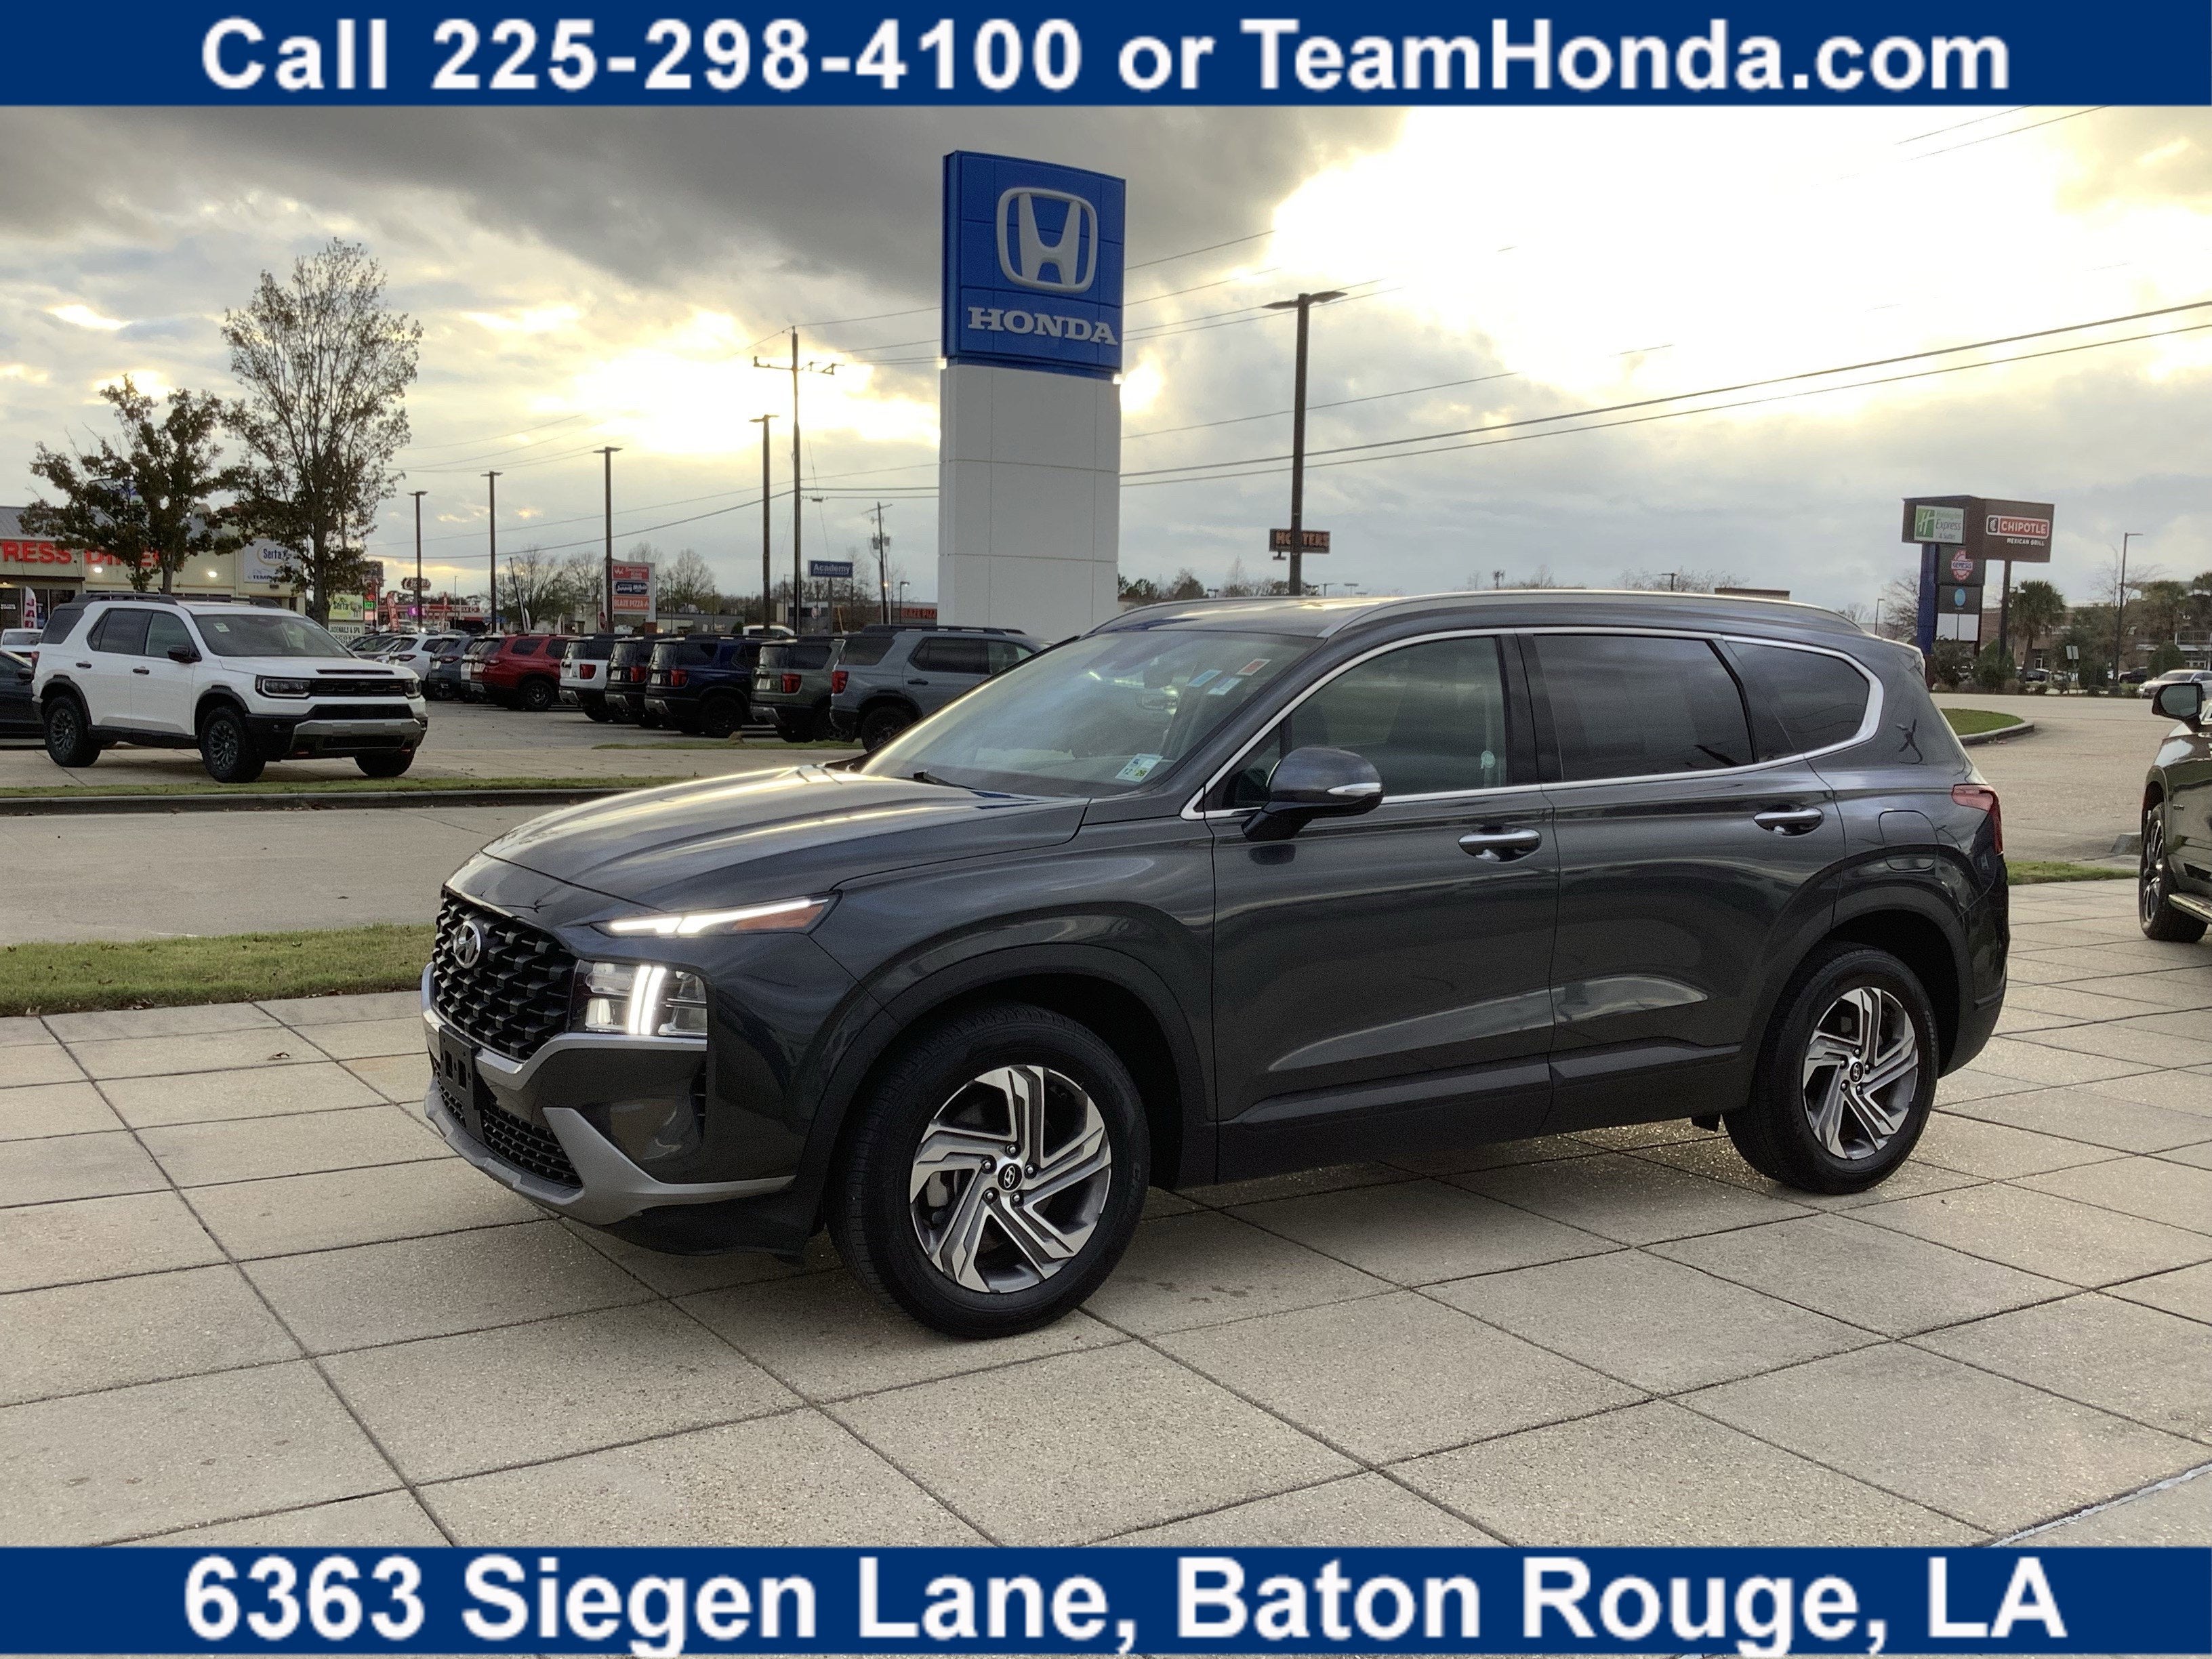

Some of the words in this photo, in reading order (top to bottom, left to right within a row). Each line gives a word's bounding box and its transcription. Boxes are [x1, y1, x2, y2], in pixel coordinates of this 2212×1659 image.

[968, 307, 1118, 346] HONDA
[1936, 518, 1961, 531] Express
[2001, 520, 2047, 535] CHIPOTLE
[1275, 531, 1329, 547] HOTERS
[2, 541, 72, 565] RESS
[263, 548, 282, 559] Serta
[813, 563, 851, 574] Academy
[630, 599, 644, 607] PIZZA
